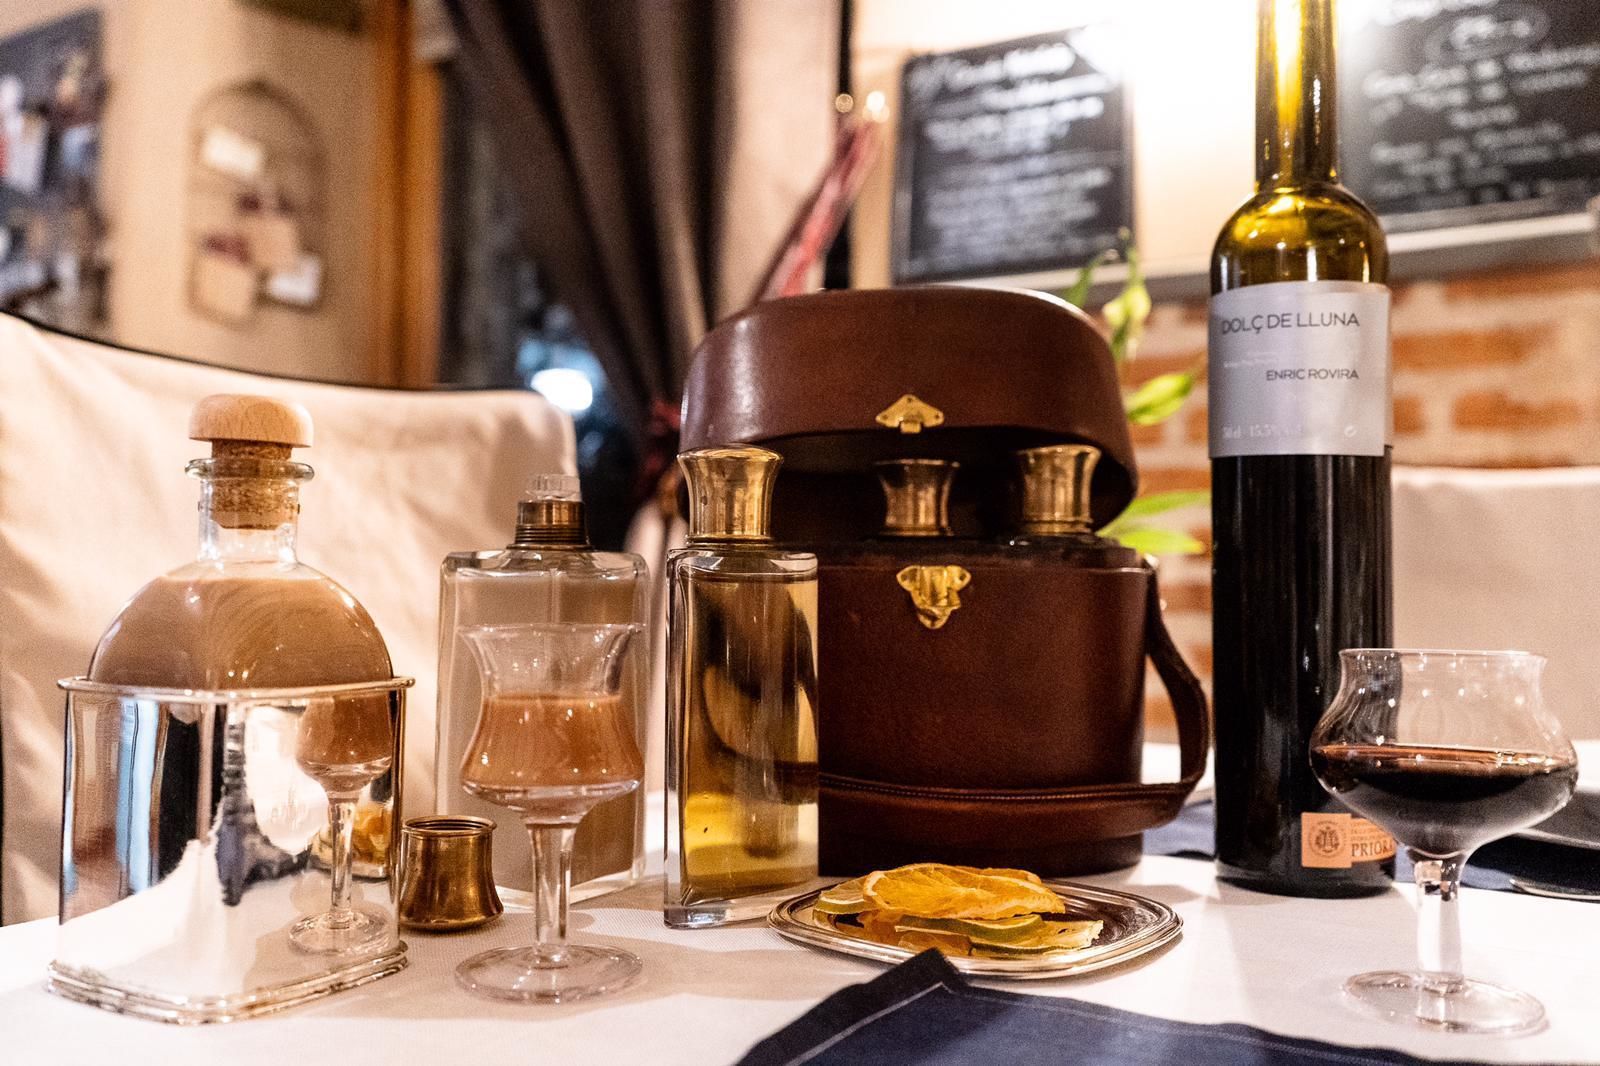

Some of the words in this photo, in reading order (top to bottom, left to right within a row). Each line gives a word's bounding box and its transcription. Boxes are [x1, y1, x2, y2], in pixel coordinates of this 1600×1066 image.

[1222, 315, 1263, 334] DOLÇ
[1267, 314, 1293, 329] DE
[1296, 312, 1360, 328] LLUNA
[1266, 369, 1305, 381] ENRIC
[1308, 369, 1359, 380] ROVIRA
